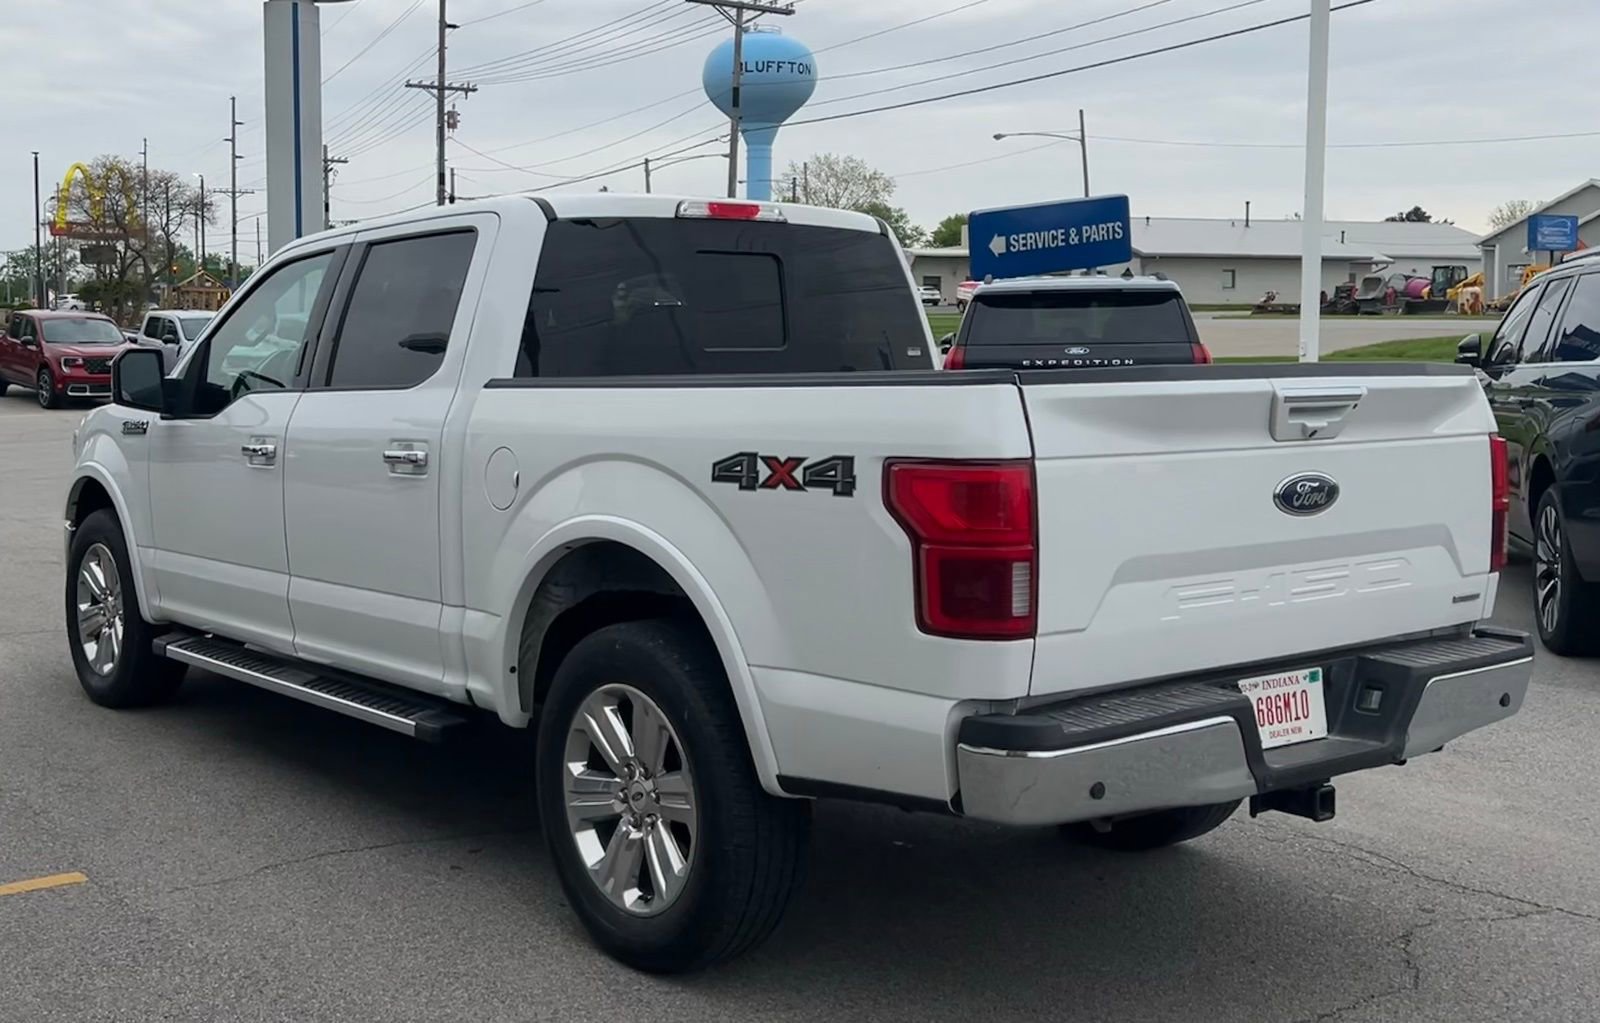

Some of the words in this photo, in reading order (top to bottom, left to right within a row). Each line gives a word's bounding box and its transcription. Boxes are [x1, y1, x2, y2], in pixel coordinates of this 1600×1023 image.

[1010, 229, 1066, 252] SERVICE
[1069, 227, 1079, 245] &
[1082, 221, 1124, 243] PARTS
[1293, 481, 1329, 507] Ford
[1262, 675, 1301, 691] INDIANA
[1256, 689, 1310, 728] 686M10
[1268, 728, 1290, 740] DEALER
[1290, 725, 1303, 736] NEW
